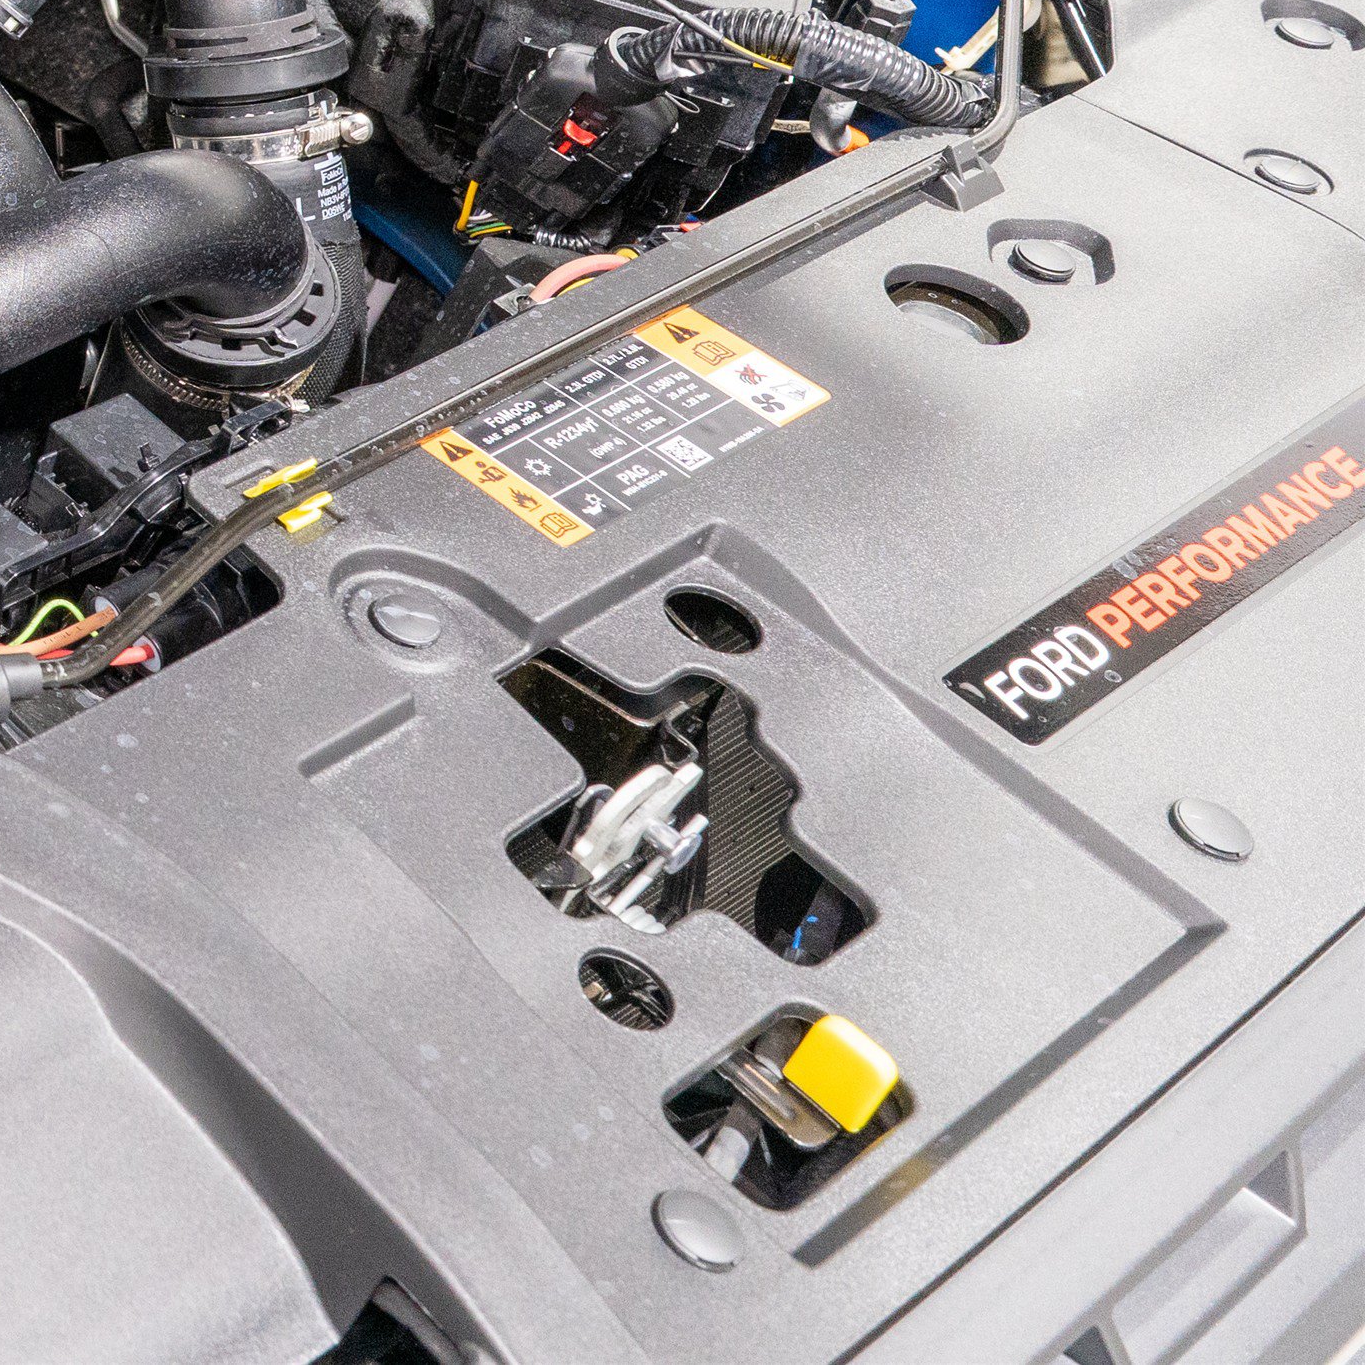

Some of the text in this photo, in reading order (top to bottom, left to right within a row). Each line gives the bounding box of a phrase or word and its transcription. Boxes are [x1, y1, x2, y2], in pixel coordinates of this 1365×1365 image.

[317, 185, 337, 198] Made
[601, 353, 623, 365] 2.7L
[624, 355, 649, 370] GTDI
[564, 369, 606, 392] 2.3L GTDI
[669, 370, 691, 382] kg
[625, 393, 646, 405] kg
[694, 391, 711, 401] lbs
[482, 399, 537, 428] FoMoCo
[649, 415, 666, 425] lbs
[482, 432, 503, 444] SAE
[543, 416, 600, 449] R-1234yf
[588, 441, 616, 458] (GWP
[615, 464, 650, 485] PAG
[984, 446, 1365, 720] FORD PERFORMANCE
